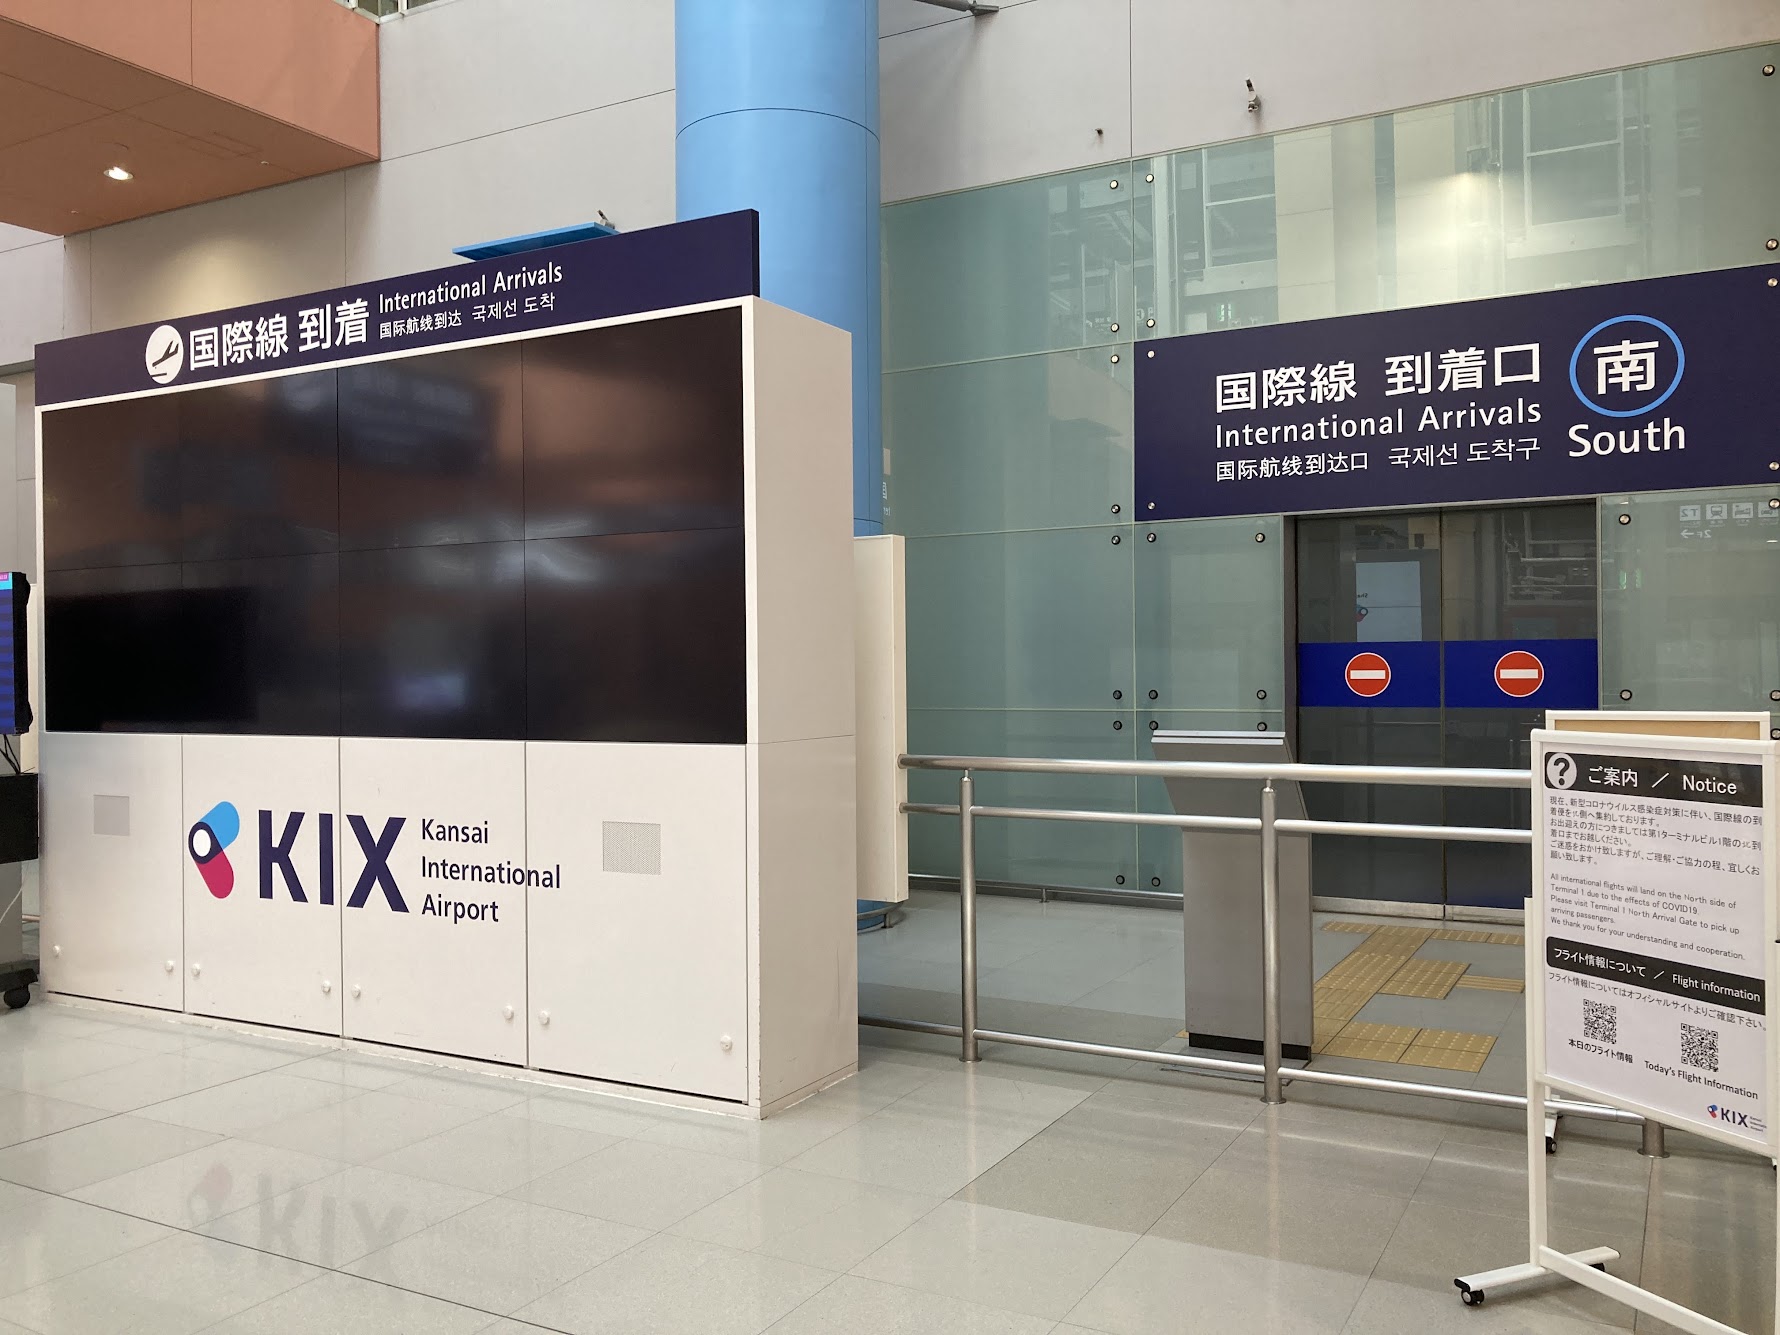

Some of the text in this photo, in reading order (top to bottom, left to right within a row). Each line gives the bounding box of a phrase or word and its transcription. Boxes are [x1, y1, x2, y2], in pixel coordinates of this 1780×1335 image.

[379, 261, 563, 314] International Arrivals
[471, 291, 556, 323] 국제선 도착
[189, 297, 370, 371] 国際線 到着
[379, 310, 463, 340] 国际航线到达
[1216, 342, 1540, 414] 国際線 到着口
[1593, 339, 1659, 395] 南
[1216, 398, 1542, 449] International Arrivals
[1568, 417, 1686, 458] South
[1216, 451, 1368, 482] 国际航线到达口
[1388, 437, 1541, 469] 국제선 도착구
[1588, 765, 1638, 788] ご案内
[1682, 774, 1738, 795] Notice
[422, 818, 489, 844] Kansai
[258, 809, 410, 914] KIX
[422, 855, 561, 889] International
[1551, 884, 1578, 894] Terminal
[1586, 890, 1599, 898] due
[1610, 894, 1622, 902] the
[1624, 896, 1650, 906] effects
[1652, 900, 1660, 908] of
[1561, 874, 1601, 887] international
[1604, 881, 1624, 890] flights
[1640, 887, 1655, 896] land
[1669, 892, 1681, 900] the
[1684, 894, 1707, 904] North
[1710, 898, 1725, 907] side
[1728, 901, 1736, 909] of
[421, 893, 499, 925] Airport
[1551, 894, 1572, 905] Please
[1574, 900, 1588, 908] visit
[1590, 901, 1620, 913] Terminal
[1628, 908, 1650, 918] North
[1652, 912, 1676, 923] Arrival
[1679, 916, 1698, 927] Gate
[1700, 920, 1708, 929] to
[1710, 923, 1727, 932] pick
[1730, 927, 1740, 935] up
[1551, 907, 1616, 924] arriving passengers.
[1551, 916, 1560, 924] We
[1562, 919, 1580, 928] thank
[1596, 924, 1607, 934] for
[1609, 928, 1625, 936] your
[1626, 932, 1678, 948] understanding
[1680, 942, 1694, 950] and
[1554, 948, 1646, 977] フライト情報について
[1672, 974, 1699, 989] Flight
[1701, 980, 1761, 1002] information
[1568, 1038, 1633, 1064] 本日のフライト情報
[1644, 1060, 1759, 1100] Today's Flight Information
[1720, 1107, 1749, 1128] KIX
